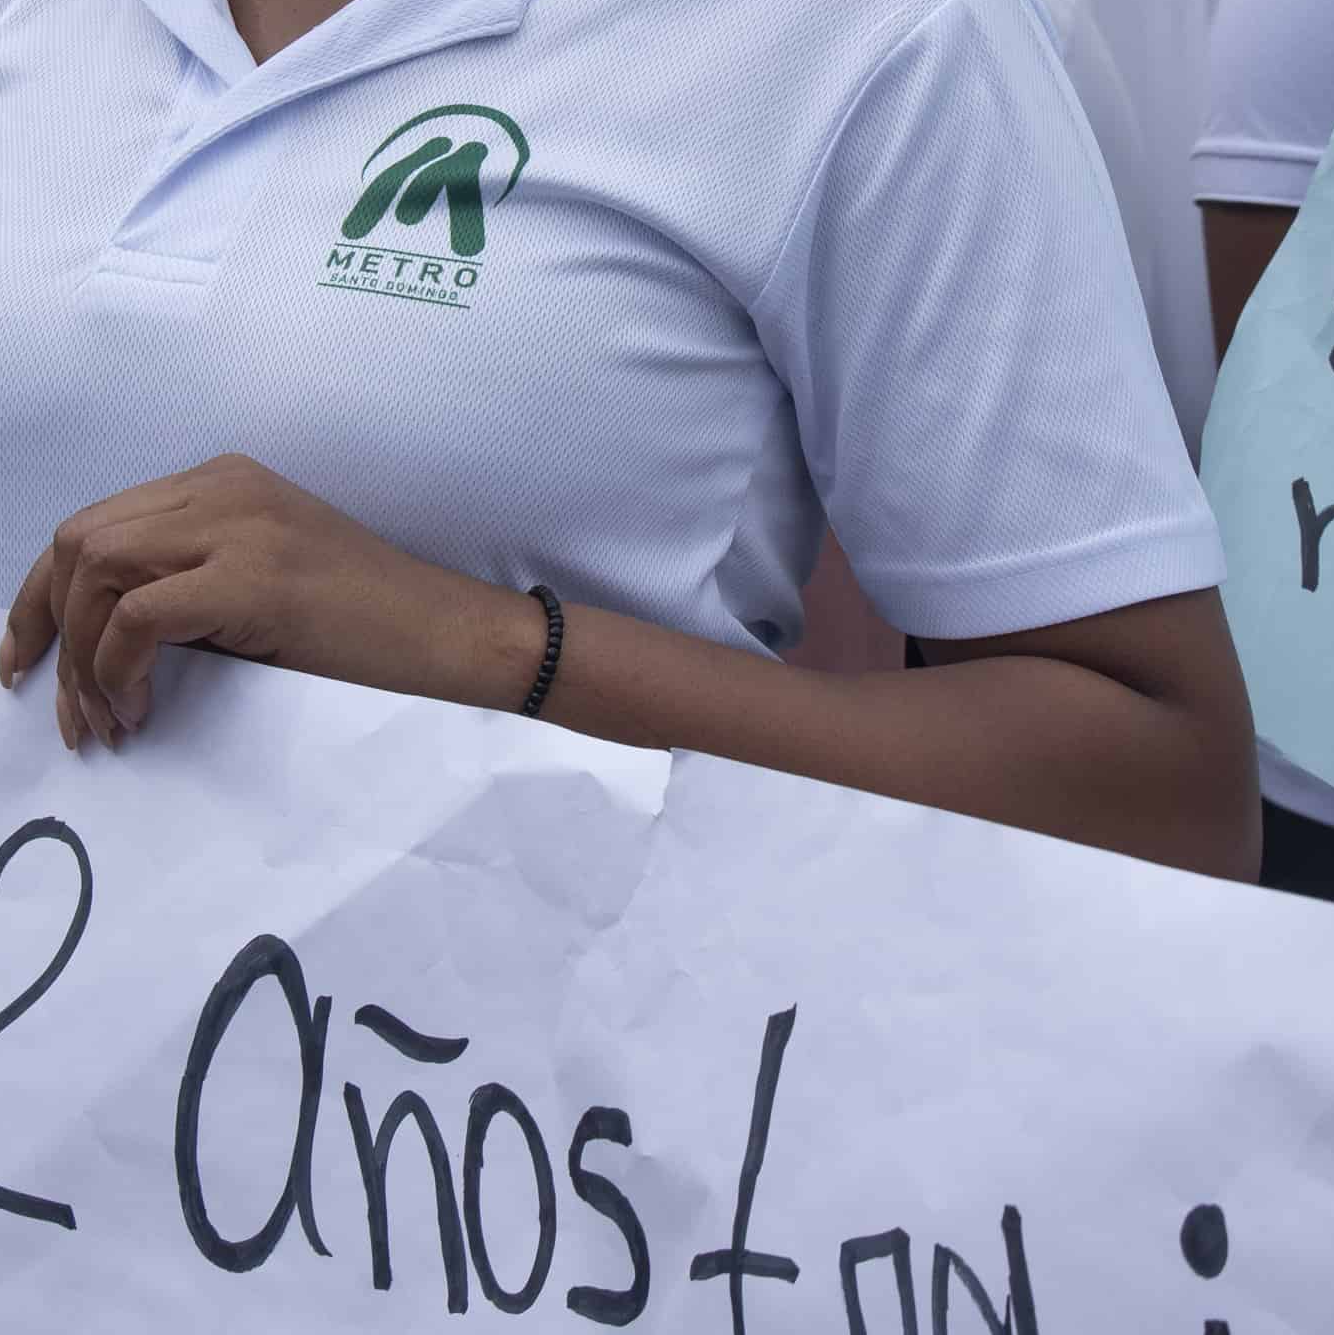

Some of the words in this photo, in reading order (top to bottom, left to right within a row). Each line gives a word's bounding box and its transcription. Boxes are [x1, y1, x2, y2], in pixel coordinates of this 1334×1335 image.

[325, 248, 479, 289] METRO
[328, 272, 380, 288] SANTO
[385, 281, 460, 302] DOMINGO
